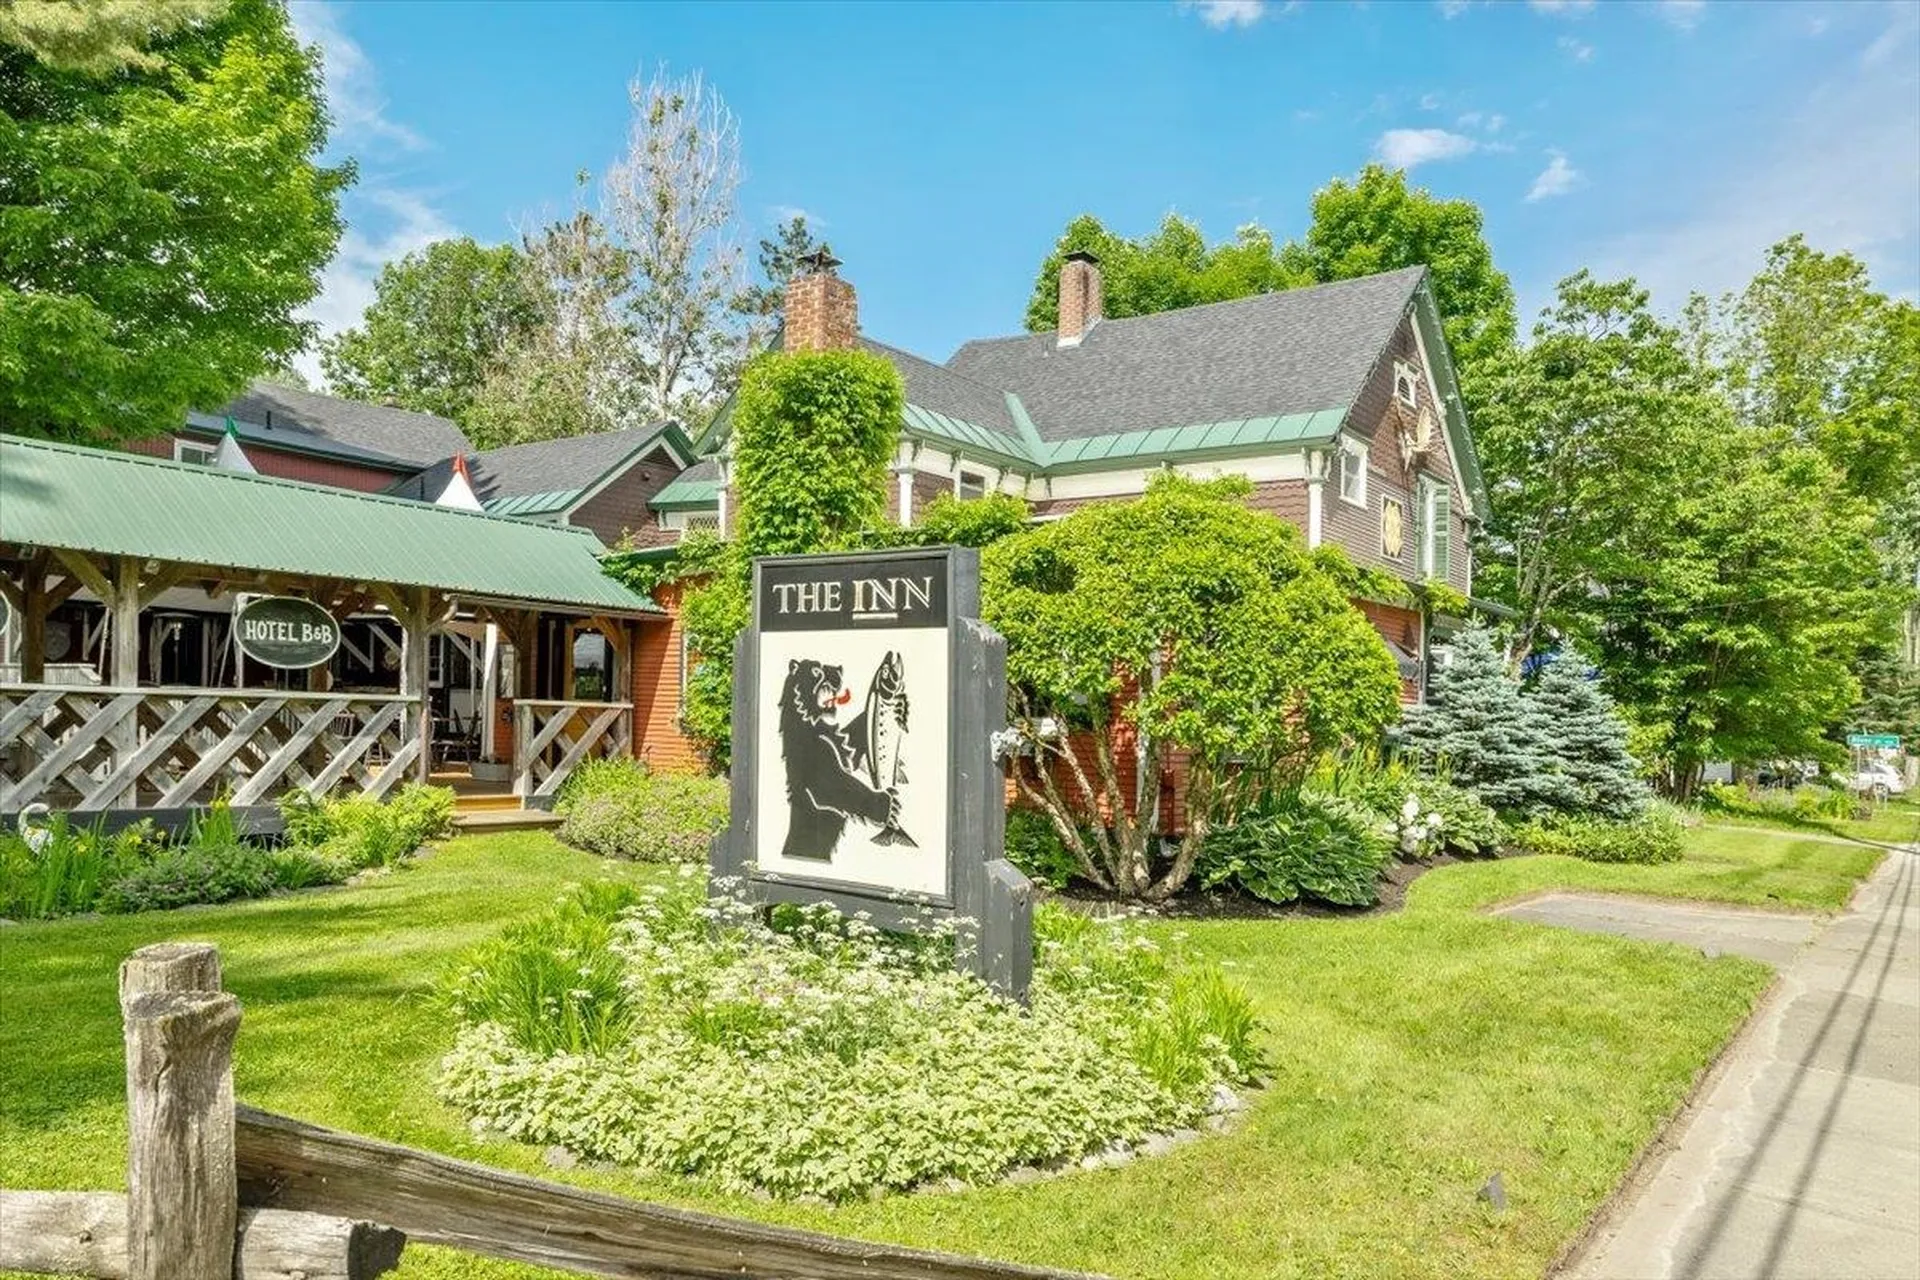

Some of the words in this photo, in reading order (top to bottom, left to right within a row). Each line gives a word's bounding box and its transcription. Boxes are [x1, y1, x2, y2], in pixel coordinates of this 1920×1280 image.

[771, 581, 842, 614] THE
[852, 576, 934, 613] INN
[244, 619, 299, 642] HOTEL
[301, 623, 333, 645] B&B
